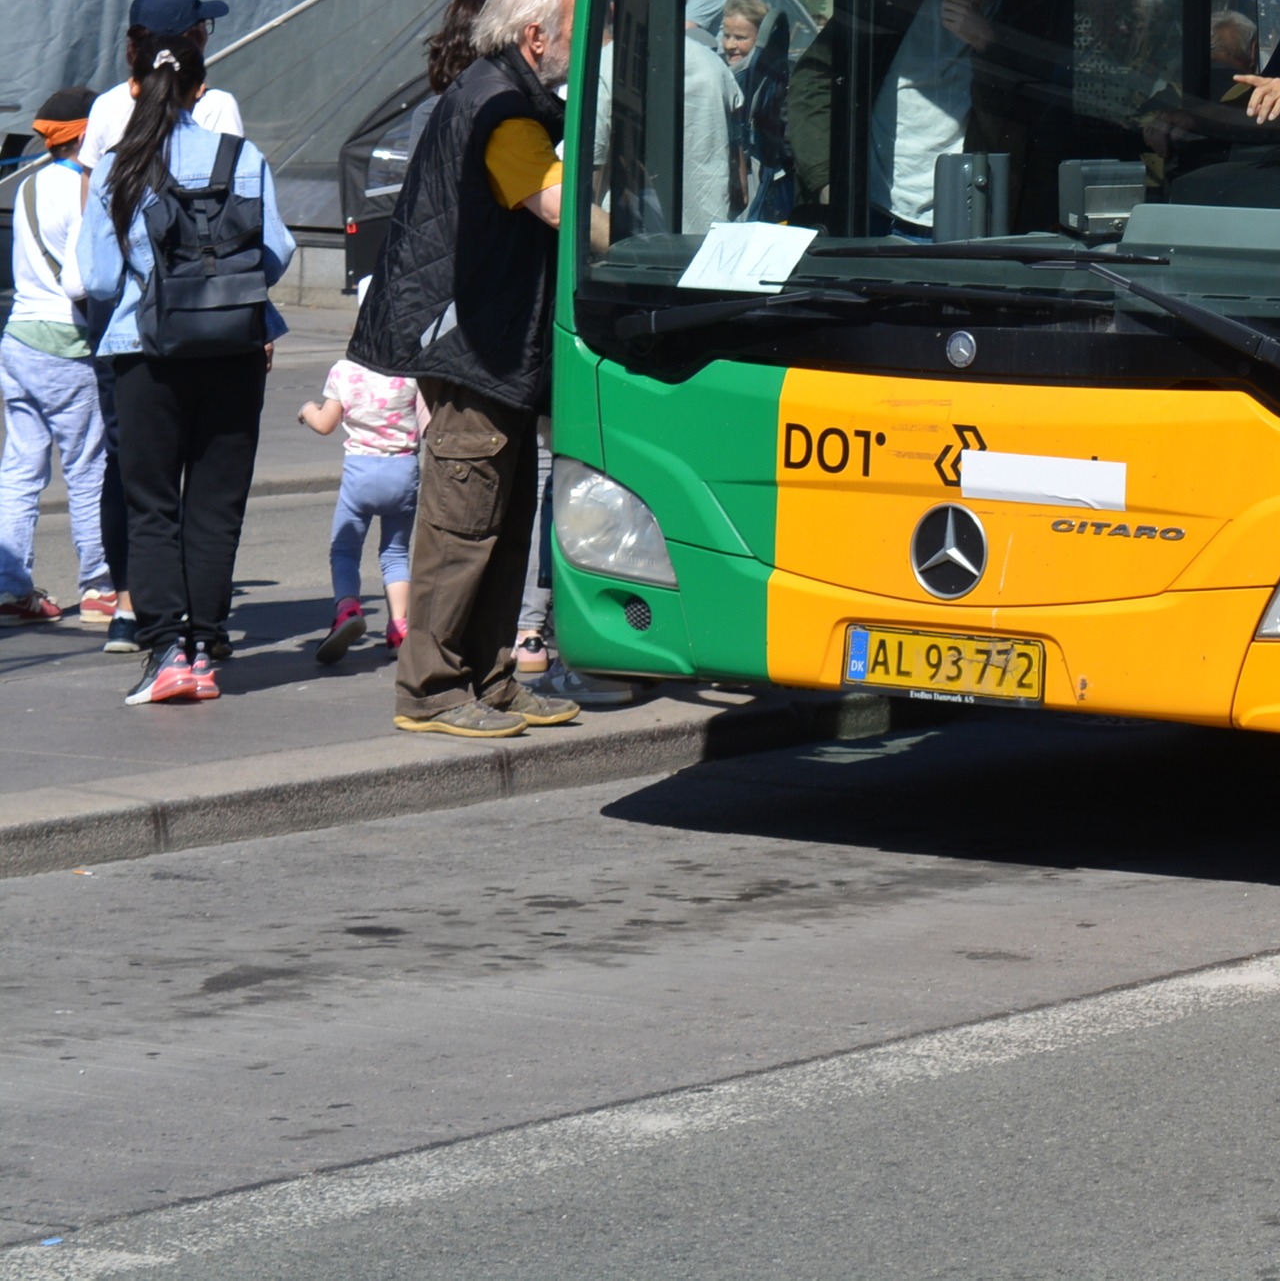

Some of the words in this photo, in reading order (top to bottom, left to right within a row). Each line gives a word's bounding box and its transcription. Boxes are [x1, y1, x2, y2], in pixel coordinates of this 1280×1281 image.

[1050, 519, 1186, 542] CITARO
[850, 659, 865, 673] DK
[870, 638, 913, 678] AL
